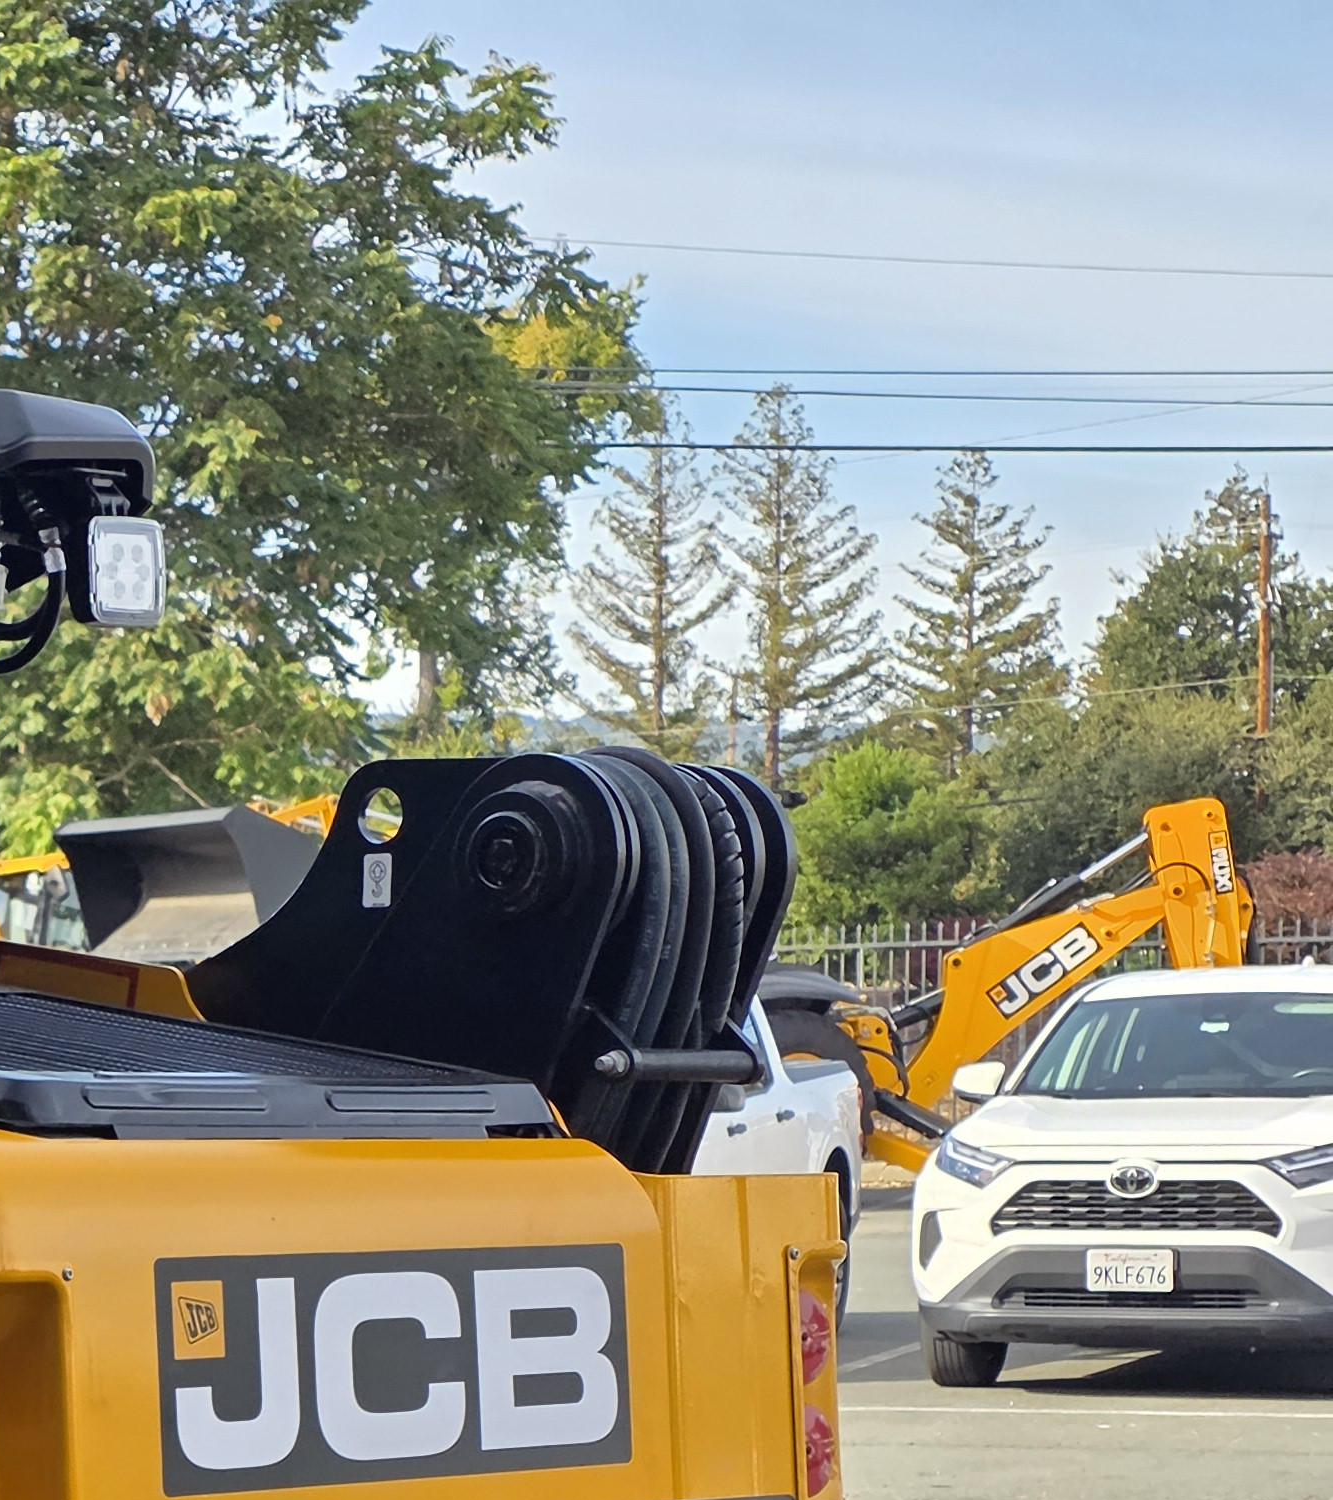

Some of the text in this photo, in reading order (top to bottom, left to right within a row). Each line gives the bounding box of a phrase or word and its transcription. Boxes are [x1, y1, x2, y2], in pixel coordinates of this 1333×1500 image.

[998, 926, 1098, 1014] JCB
[1094, 1266, 1166, 1285] 9KLF676
[186, 1302, 216, 1339] JCB
[175, 1266, 618, 1470] JCB
